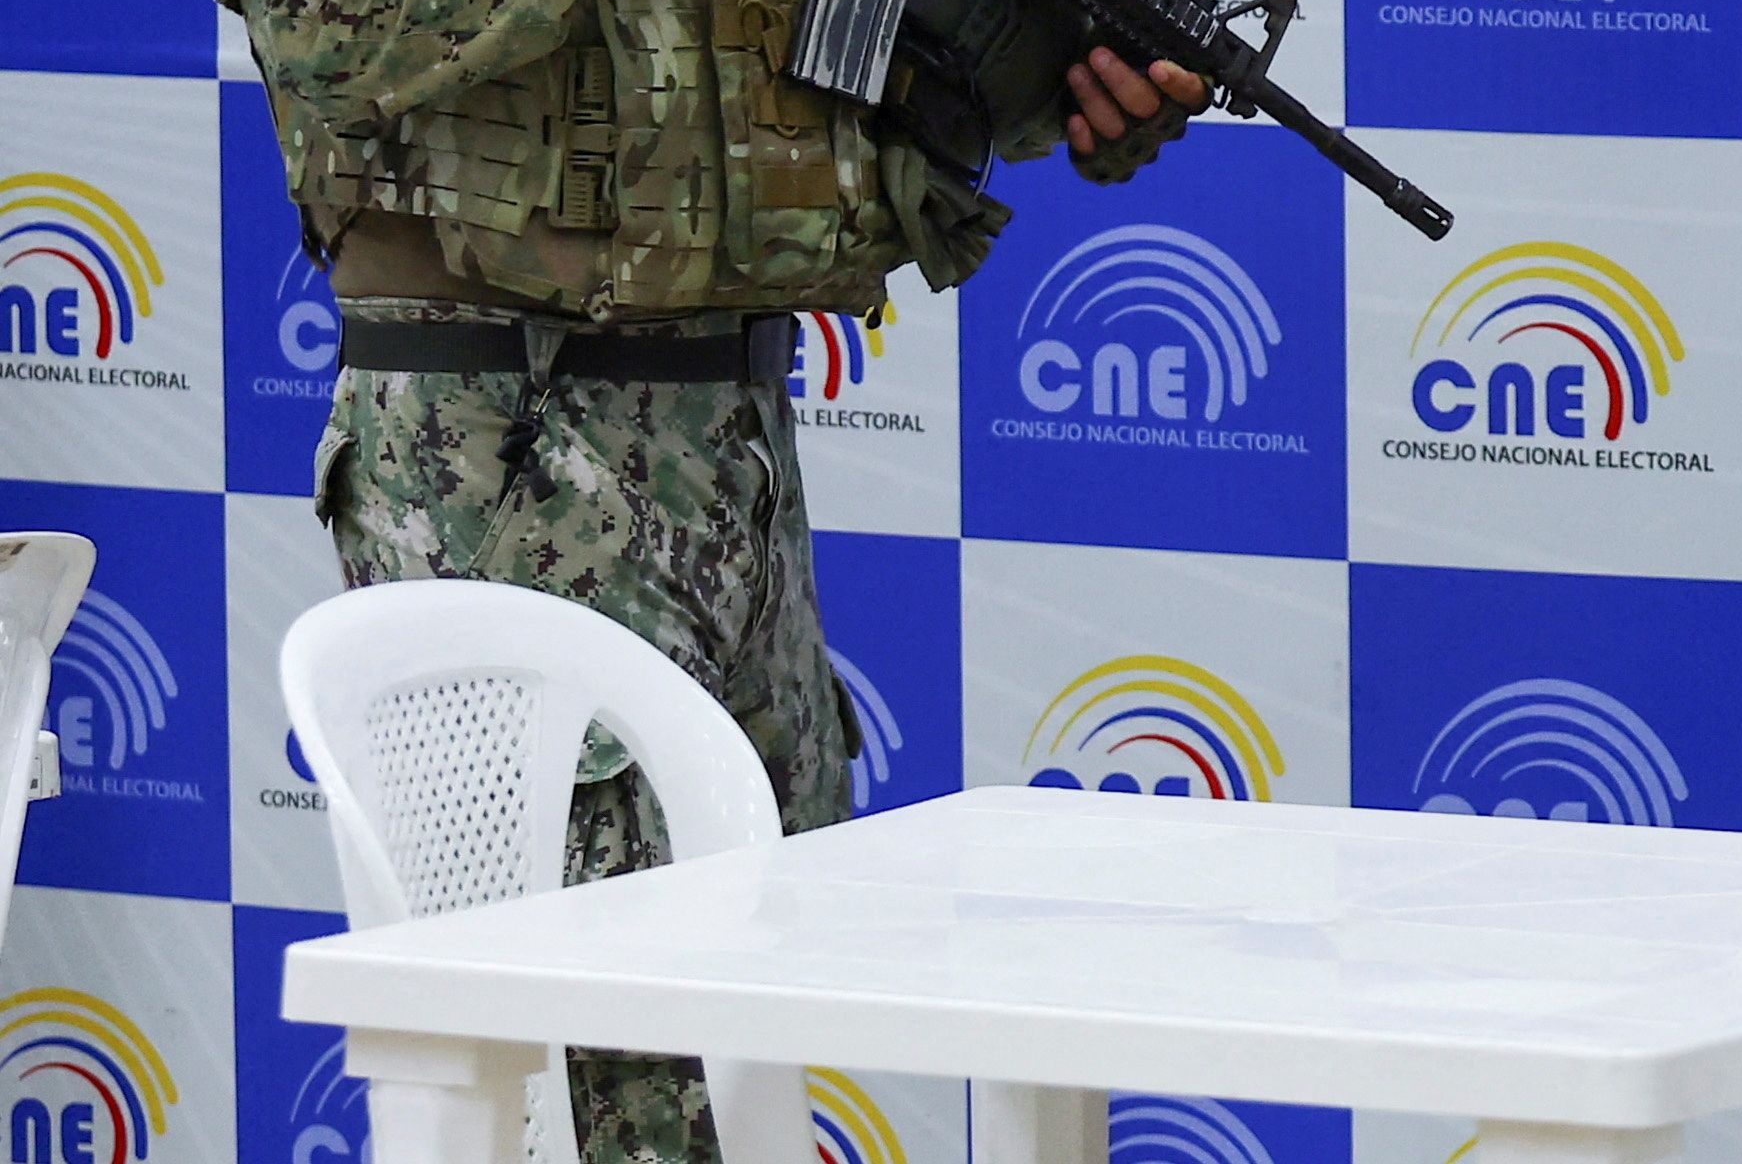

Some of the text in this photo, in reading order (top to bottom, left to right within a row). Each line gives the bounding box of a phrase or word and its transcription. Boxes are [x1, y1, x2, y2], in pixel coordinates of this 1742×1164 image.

[1379, 4, 1711, 32] CONSEJO NACIONAL ELECTORAL
[0, 284, 81, 358] NE
[88, 367, 191, 391] ELECTORAL
[1019, 339, 1187, 420] CNE
[1411, 359, 1586, 439] CNE
[815, 409, 926, 433] ELECTORAL
[991, 419, 1309, 453] CONSEJO NACIONAL ELECTORAL
[1382, 439, 1714, 473] CONSEJO NACIONAL ELECTORAL
[103, 777, 204, 801] ELECTORAL
